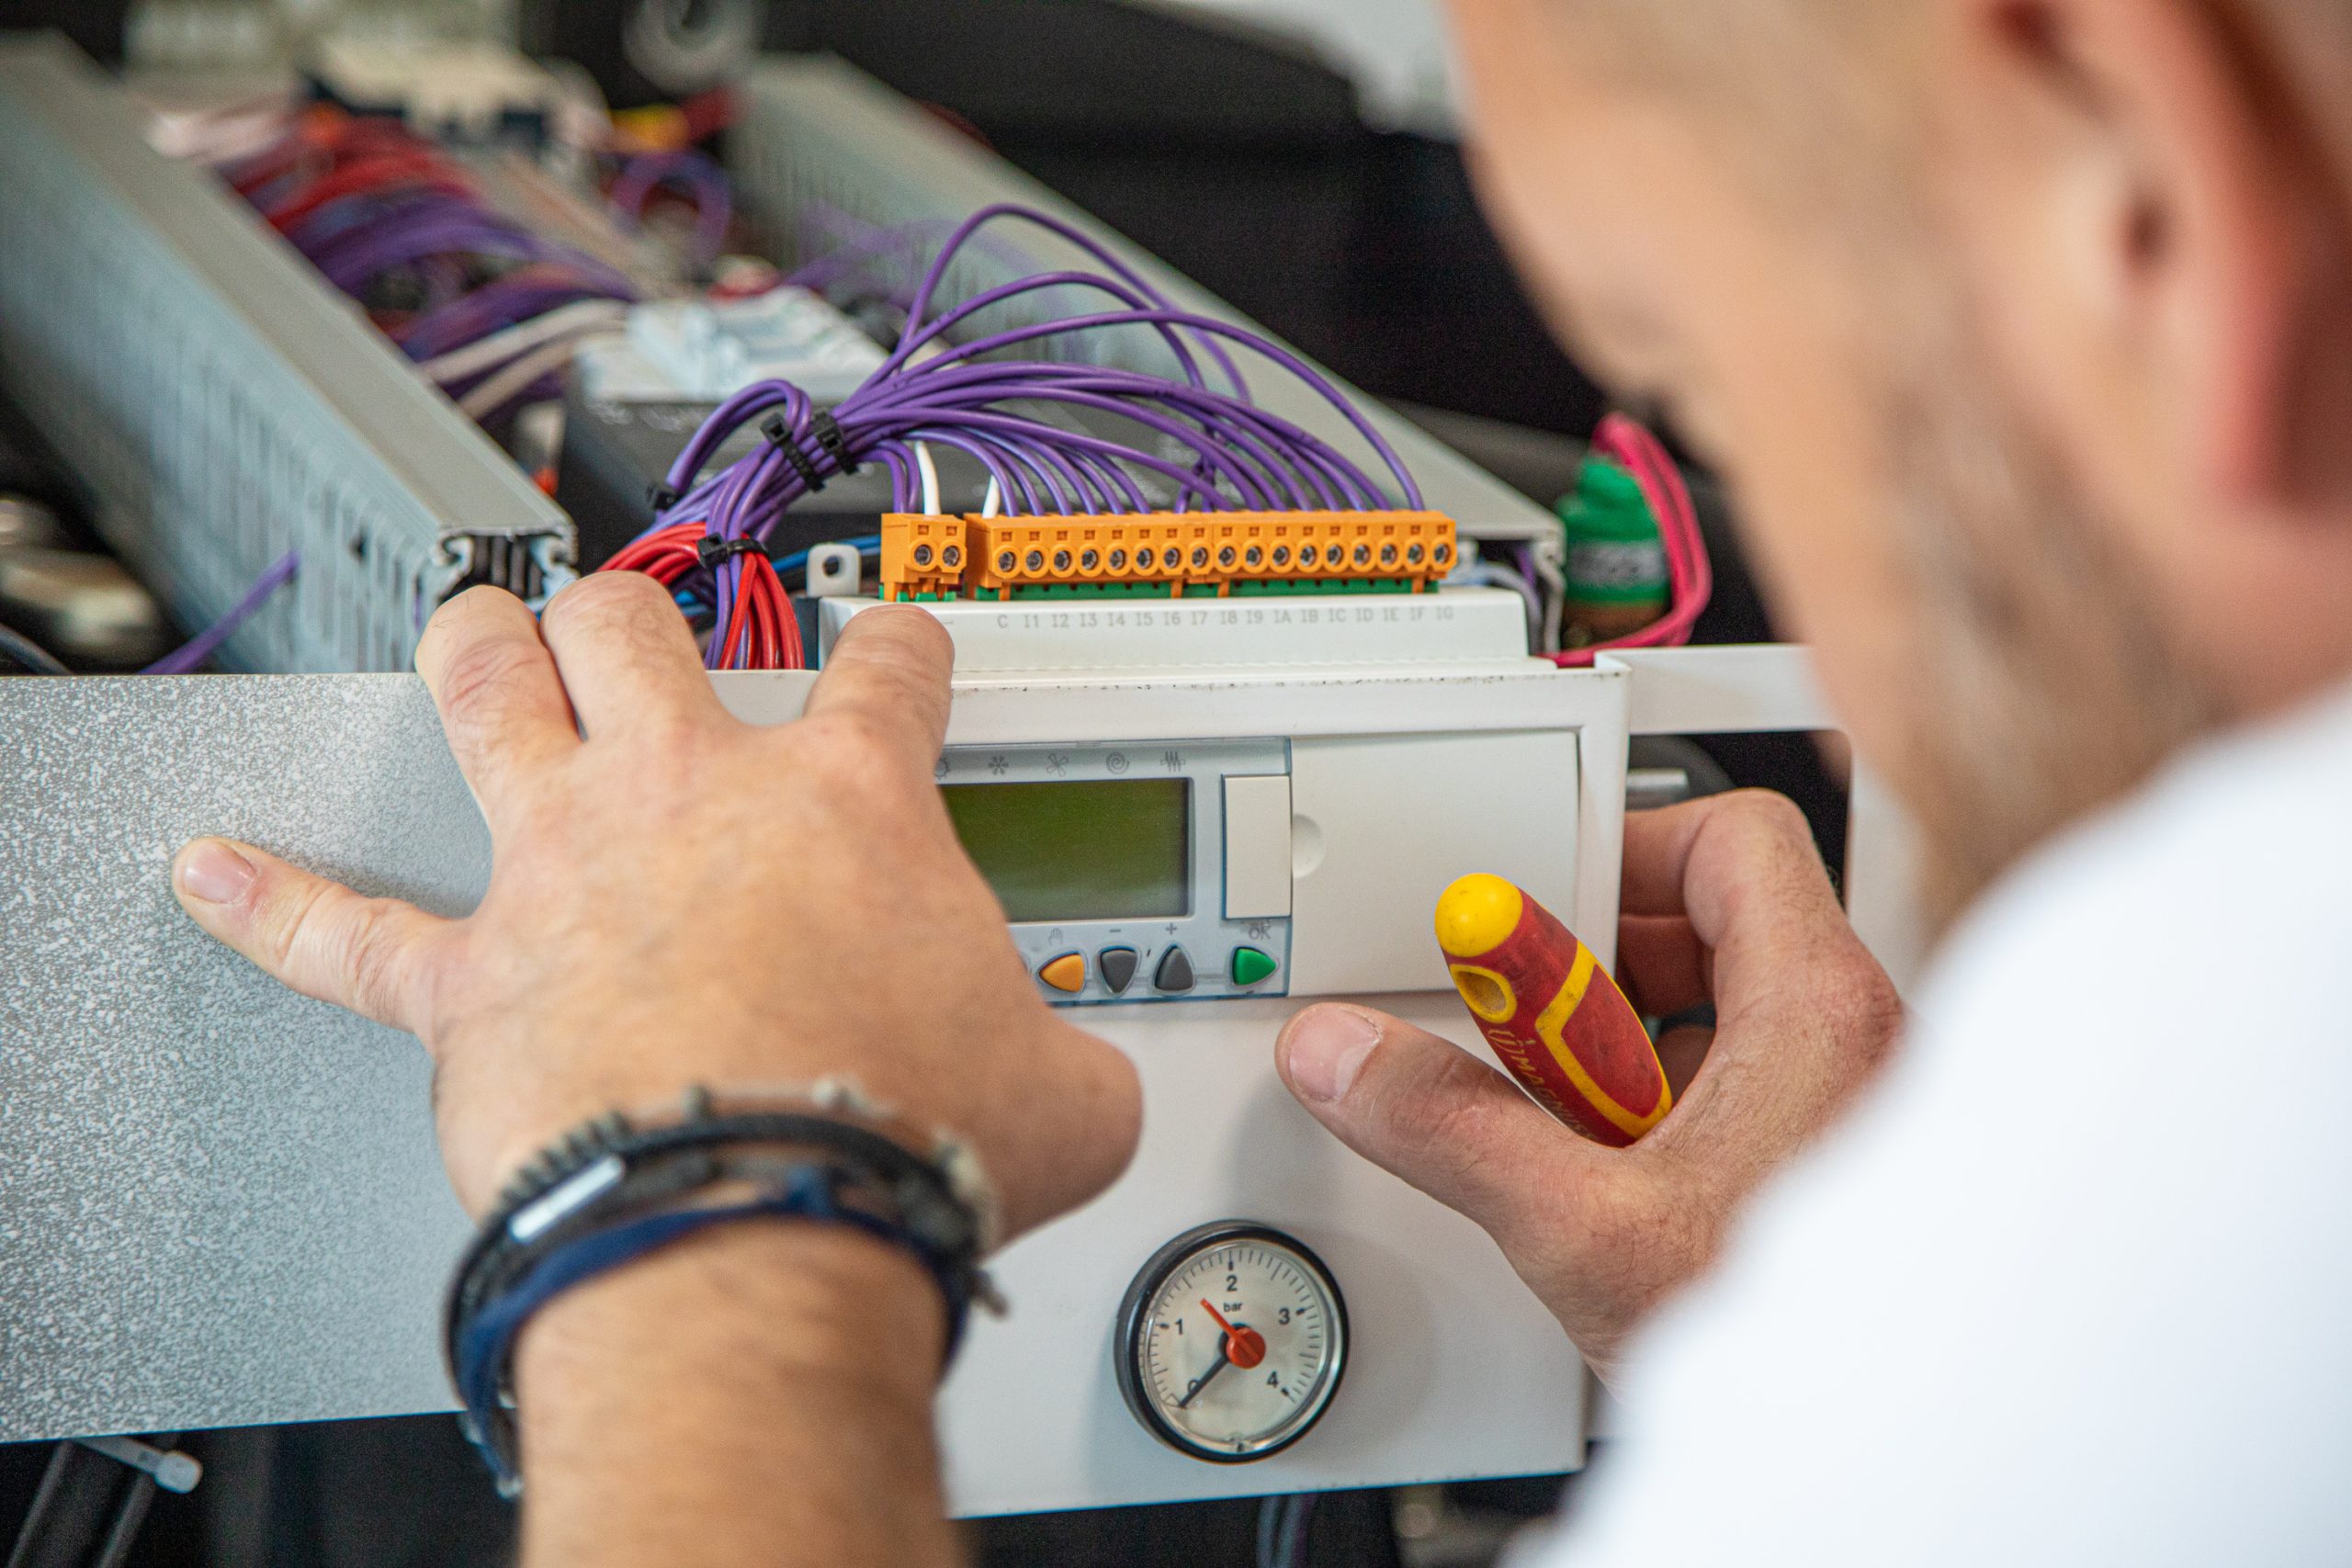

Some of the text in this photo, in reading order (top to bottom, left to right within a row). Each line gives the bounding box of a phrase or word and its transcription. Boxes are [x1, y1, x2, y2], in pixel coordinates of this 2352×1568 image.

[997, 614, 1009, 629] C
[1051, 614, 1070, 628] I2
[1080, 613, 1098, 627] I3
[1107, 612, 1125, 627] I4
[1136, 612, 1154, 626] I5
[1163, 611, 1182, 626] I6
[1191, 611, 1208, 626] I7
[1220, 610, 1238, 625] I8
[1246, 609, 1263, 625] I9
[1249, 925, 1272, 941] OK
[1226, 1274, 1238, 1292] 2
[1223, 1301, 1243, 1314] bar
[1278, 1308, 1291, 1325] 3
[1175, 1318, 1183, 1336] 1
[1266, 1371, 1279, 1389] 4
